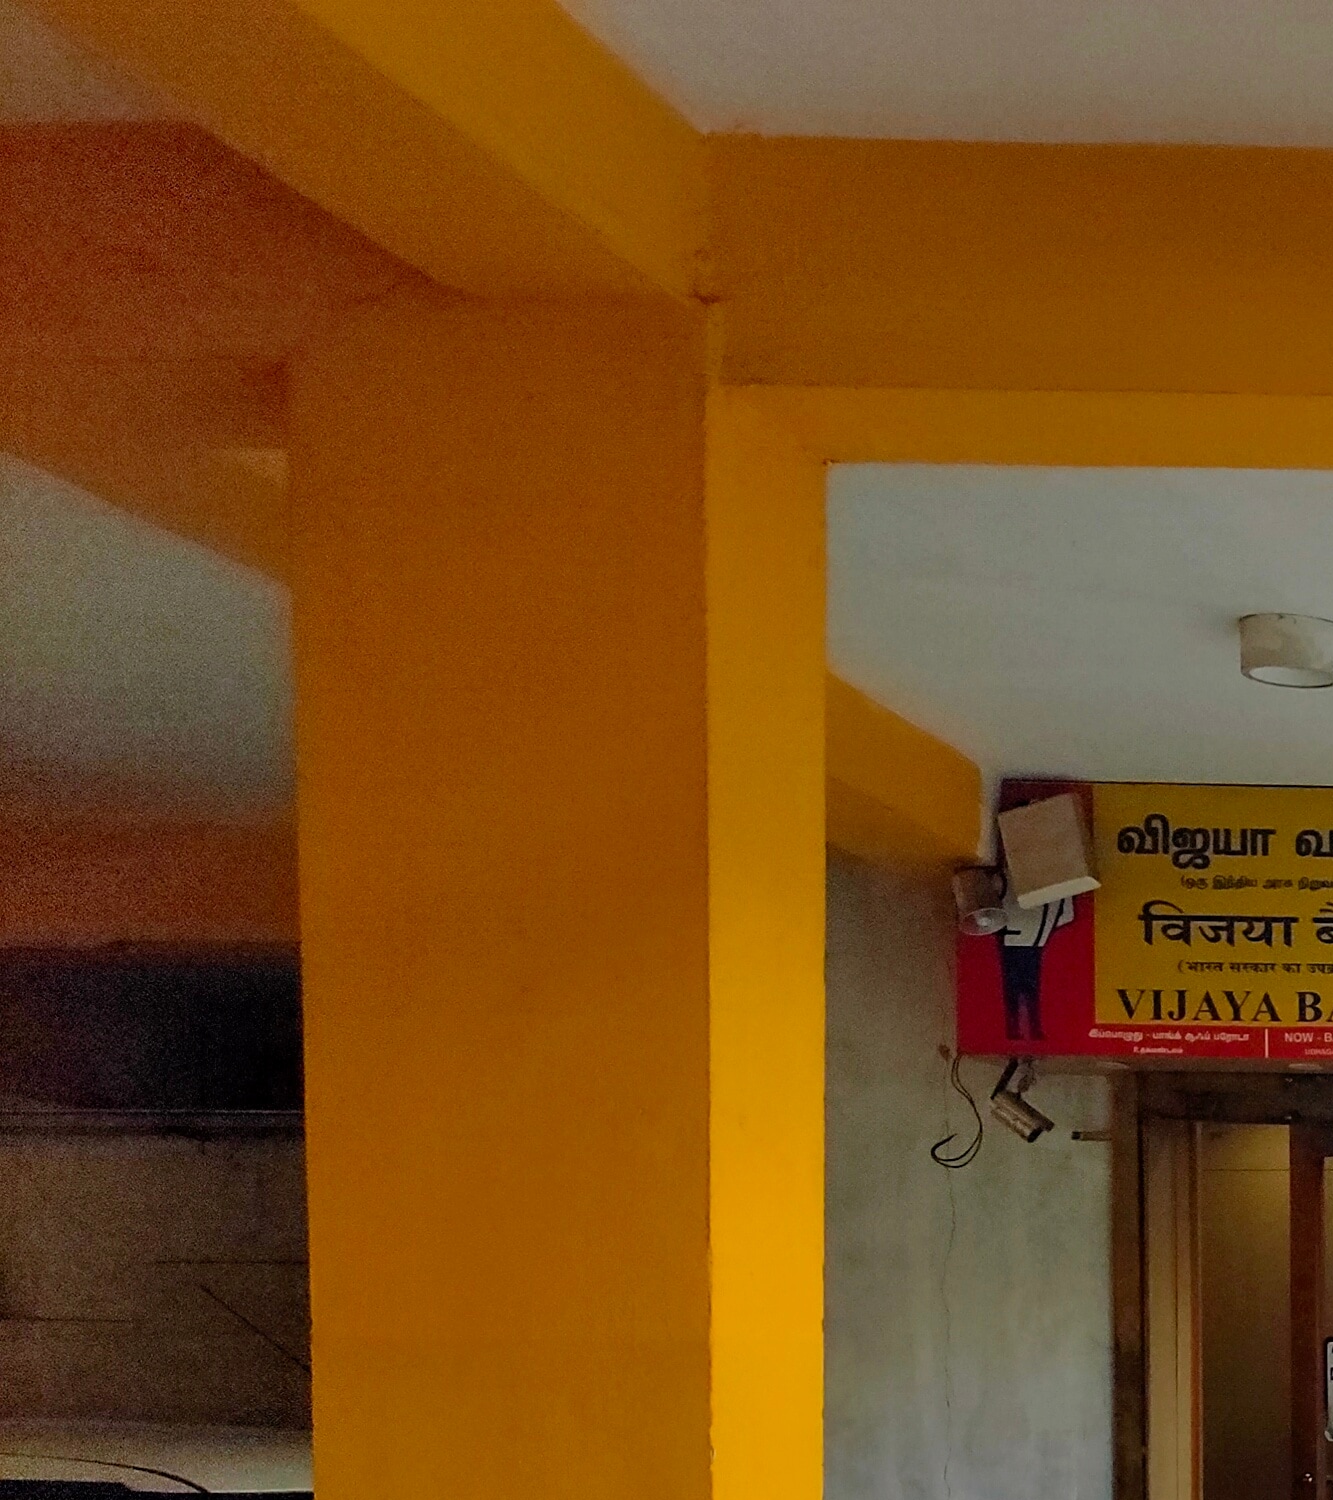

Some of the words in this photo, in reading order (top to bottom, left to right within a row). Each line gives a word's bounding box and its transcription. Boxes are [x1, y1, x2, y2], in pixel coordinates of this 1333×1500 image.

[1117, 813, 1276, 870] விஜயா
[1138, 900, 1299, 948] विजया
[1229, 962, 1277, 974] सरकार
[1282, 963, 1301, 974] का
[1116, 988, 1282, 1023] VIJAYA
[1284, 1032, 1314, 1043] NOW
